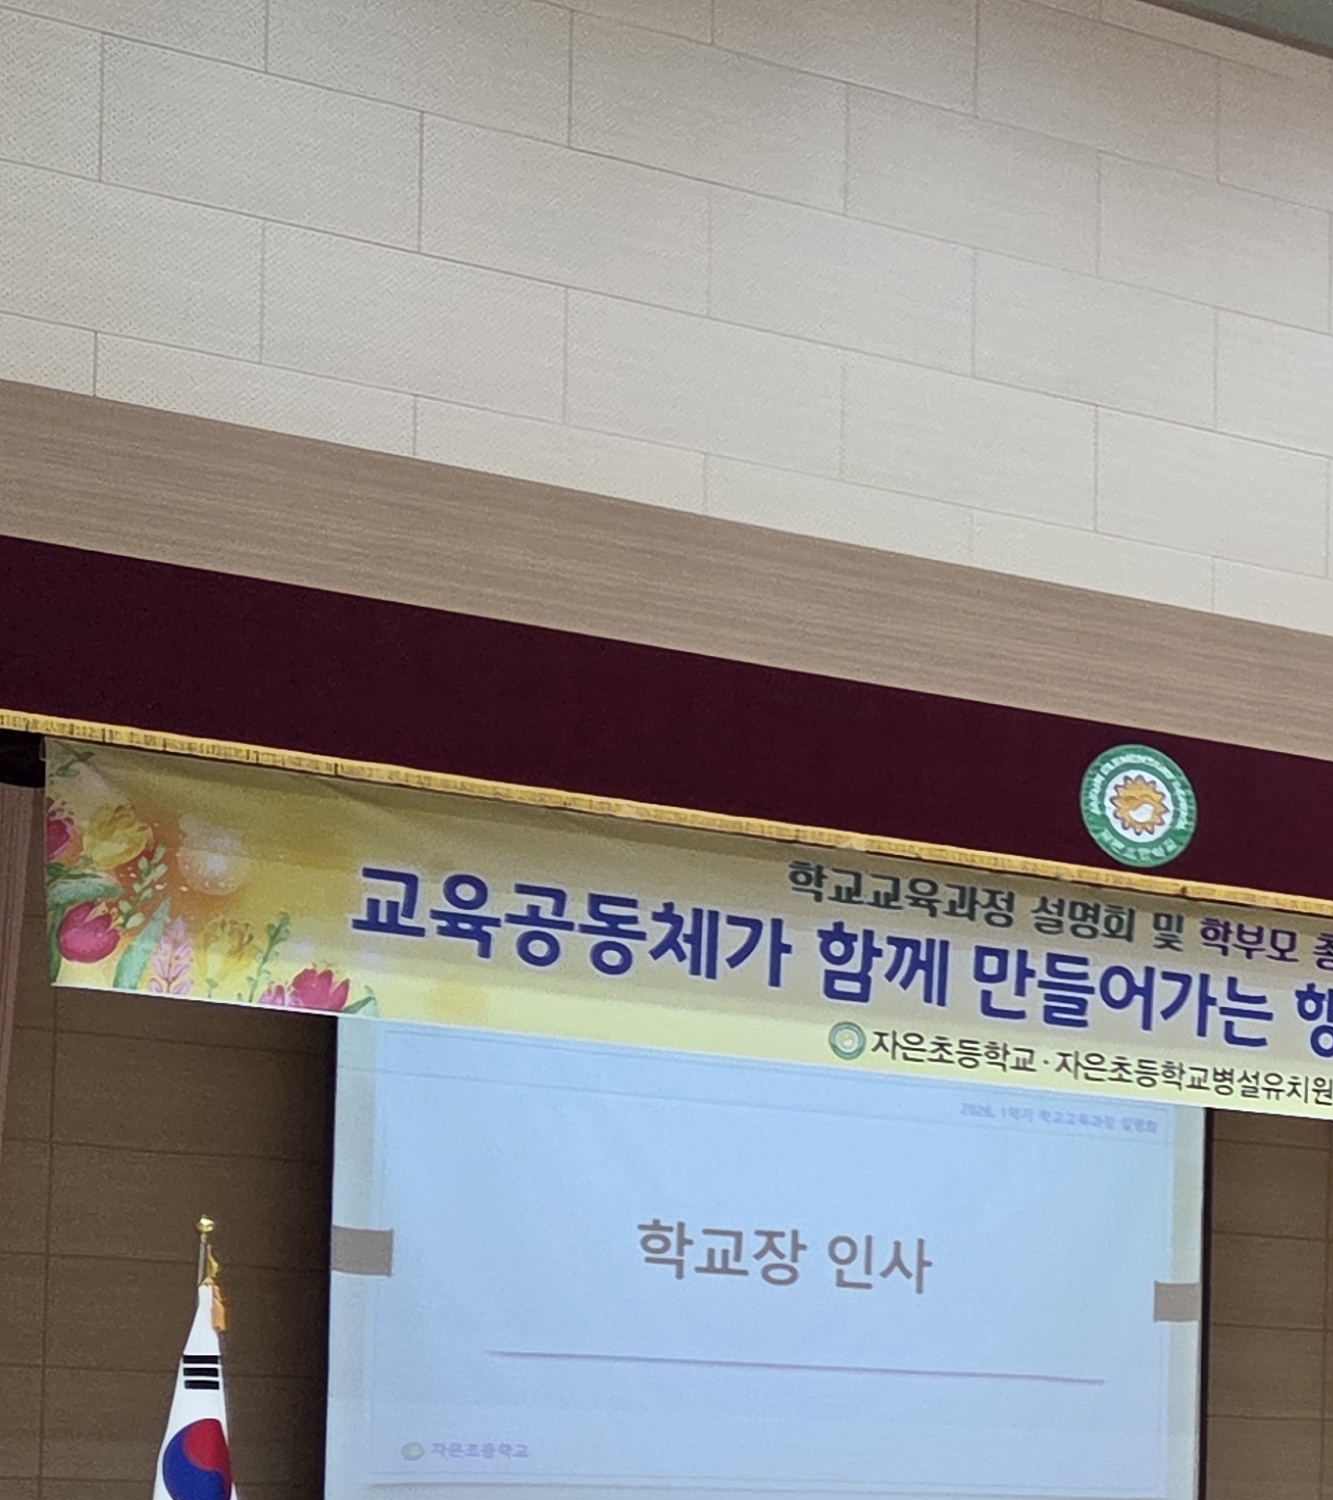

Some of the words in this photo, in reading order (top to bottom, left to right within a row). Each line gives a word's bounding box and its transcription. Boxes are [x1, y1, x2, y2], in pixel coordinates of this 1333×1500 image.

[351, 866, 792, 987] 교육공동체가
[816, 920, 949, 1008] 함께
[970, 946, 1273, 1048] 만들어가는
[788, 860, 1016, 927] 학교교육과정
[1030, 894, 1135, 943] 설명회
[1152, 912, 1186, 952] 및
[1199, 915, 1299, 964] 학부모
[637, 1218, 808, 1286] 학교장
[828, 1234, 933, 1295] 인사
